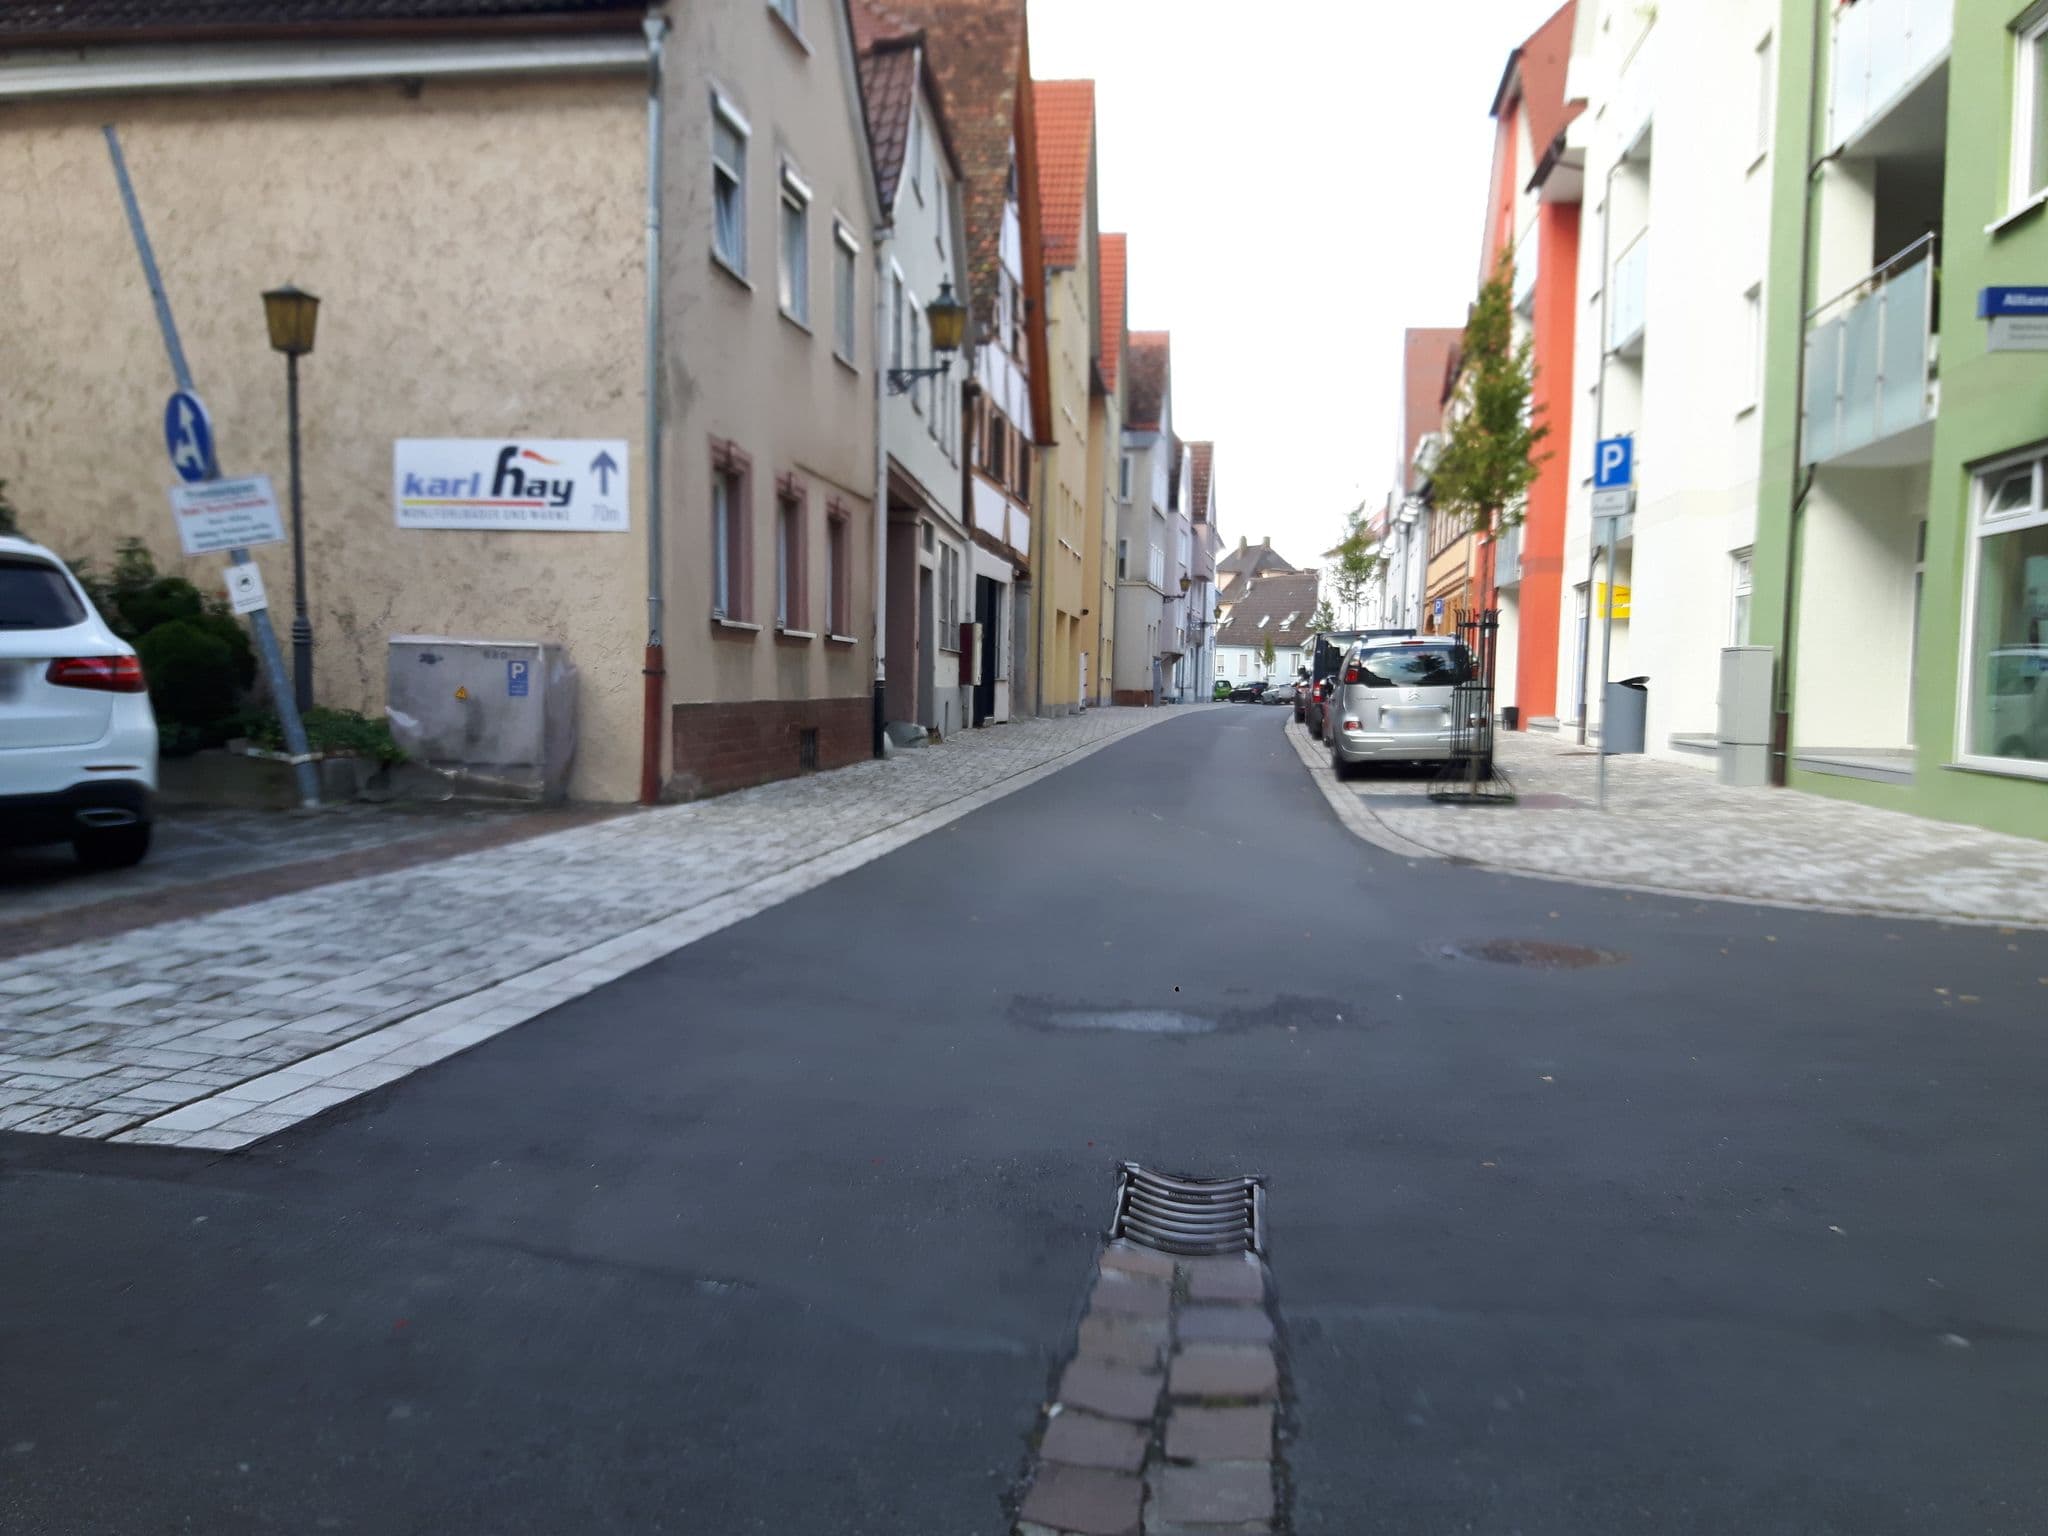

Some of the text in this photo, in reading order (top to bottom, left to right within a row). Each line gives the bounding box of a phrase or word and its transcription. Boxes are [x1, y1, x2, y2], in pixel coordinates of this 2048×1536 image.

[403, 446, 574, 507] karl hay
[1601, 443, 1624, 483] P
[511, 662, 524, 679] P
